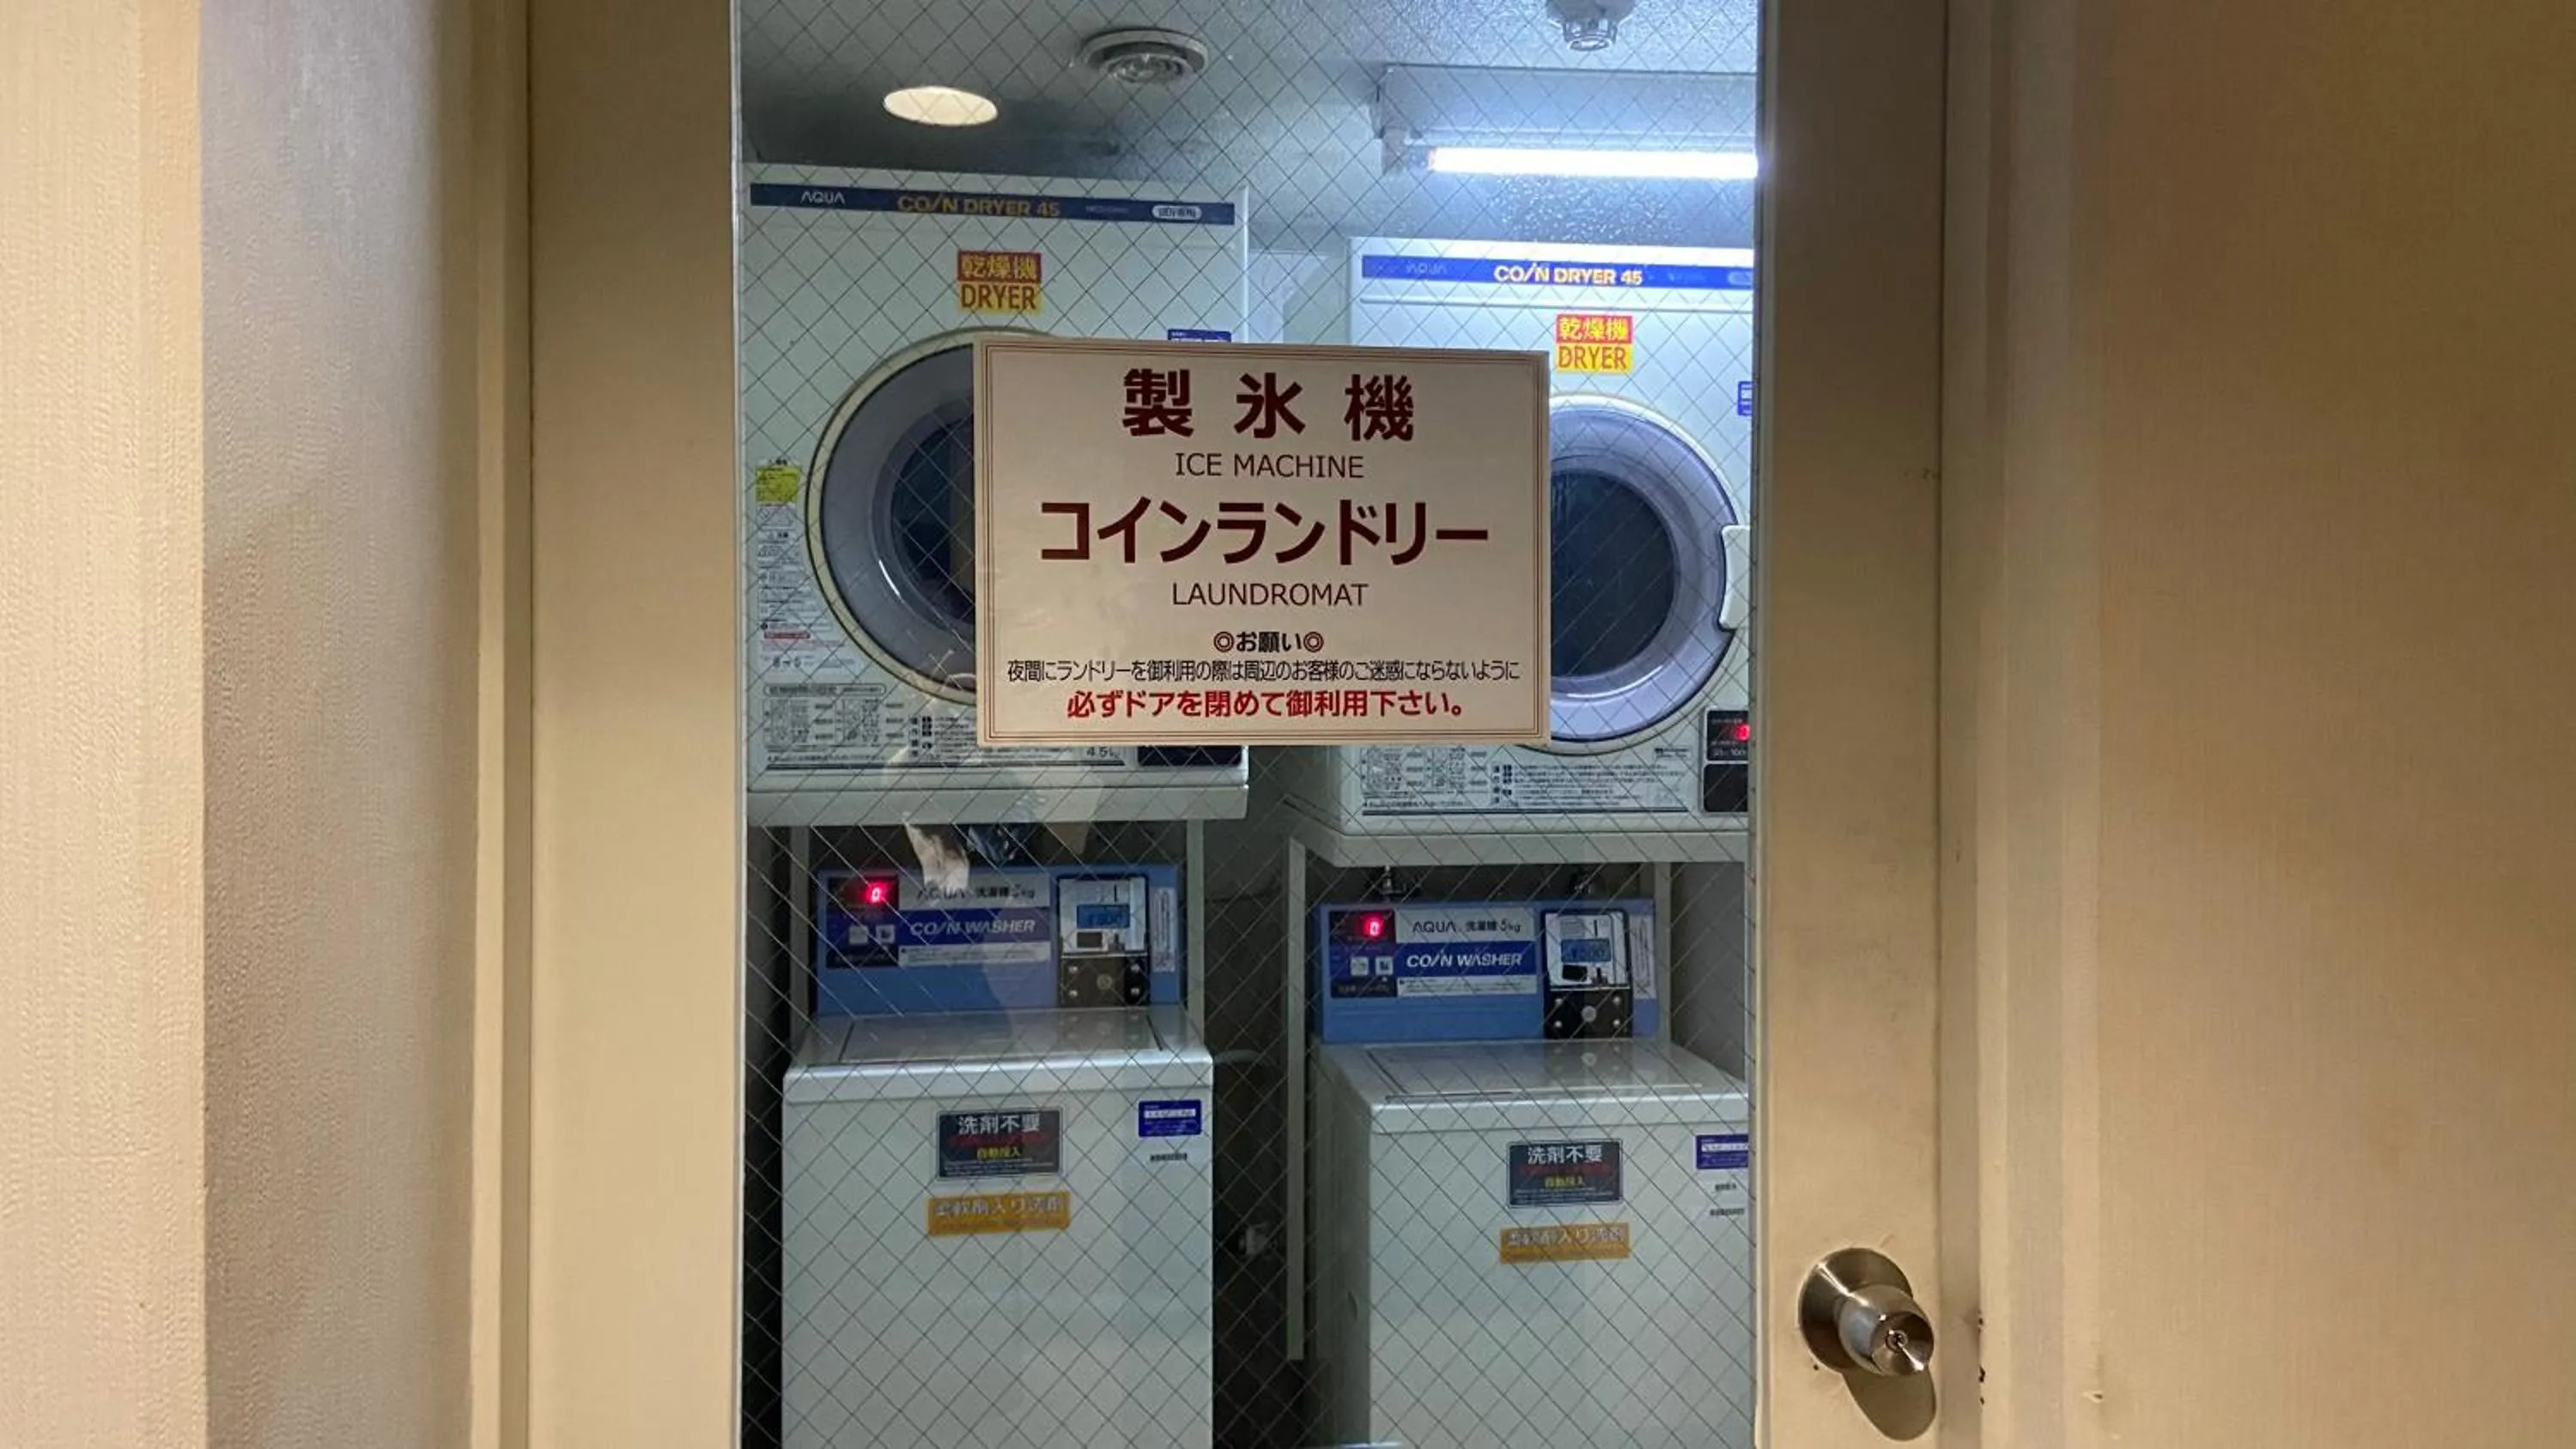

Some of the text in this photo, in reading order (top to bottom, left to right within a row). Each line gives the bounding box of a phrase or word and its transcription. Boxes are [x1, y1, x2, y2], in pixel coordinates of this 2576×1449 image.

[800, 191, 846, 206] AQUA
[963, 197, 1031, 216] DRYER
[1037, 200, 1061, 218] 45
[960, 255, 1038, 280] 乾燥機
[1554, 268, 1615, 285] DRYER
[1620, 270, 1643, 286] 45
[960, 283, 1036, 311] DRYER
[1558, 316, 1630, 341] 乾燥機
[1558, 345, 1628, 370] DRYER
[1122, 367, 1415, 442] 製氷機
[1175, 452, 1364, 478] ICE MACHINE
[1041, 495, 1489, 566] コインランドリー
[1172, 582, 1368, 607] LAUNDROMAT
[1007, 658, 1520, 682] 夜間にランドリーを御利用の際は周辺のお客様のご迷惑にならないように
[1067, 689, 1462, 718] 必ずドアを閉めて御利用下さい。
[965, 919, 1036, 934] WASHER
[1412, 919, 1457, 933] AQUA
[1457, 952, 1523, 967] WASHER
[957, 1113, 1041, 1135] 洗剤不要
[1527, 1144, 1604, 1166] 洗剤不要
